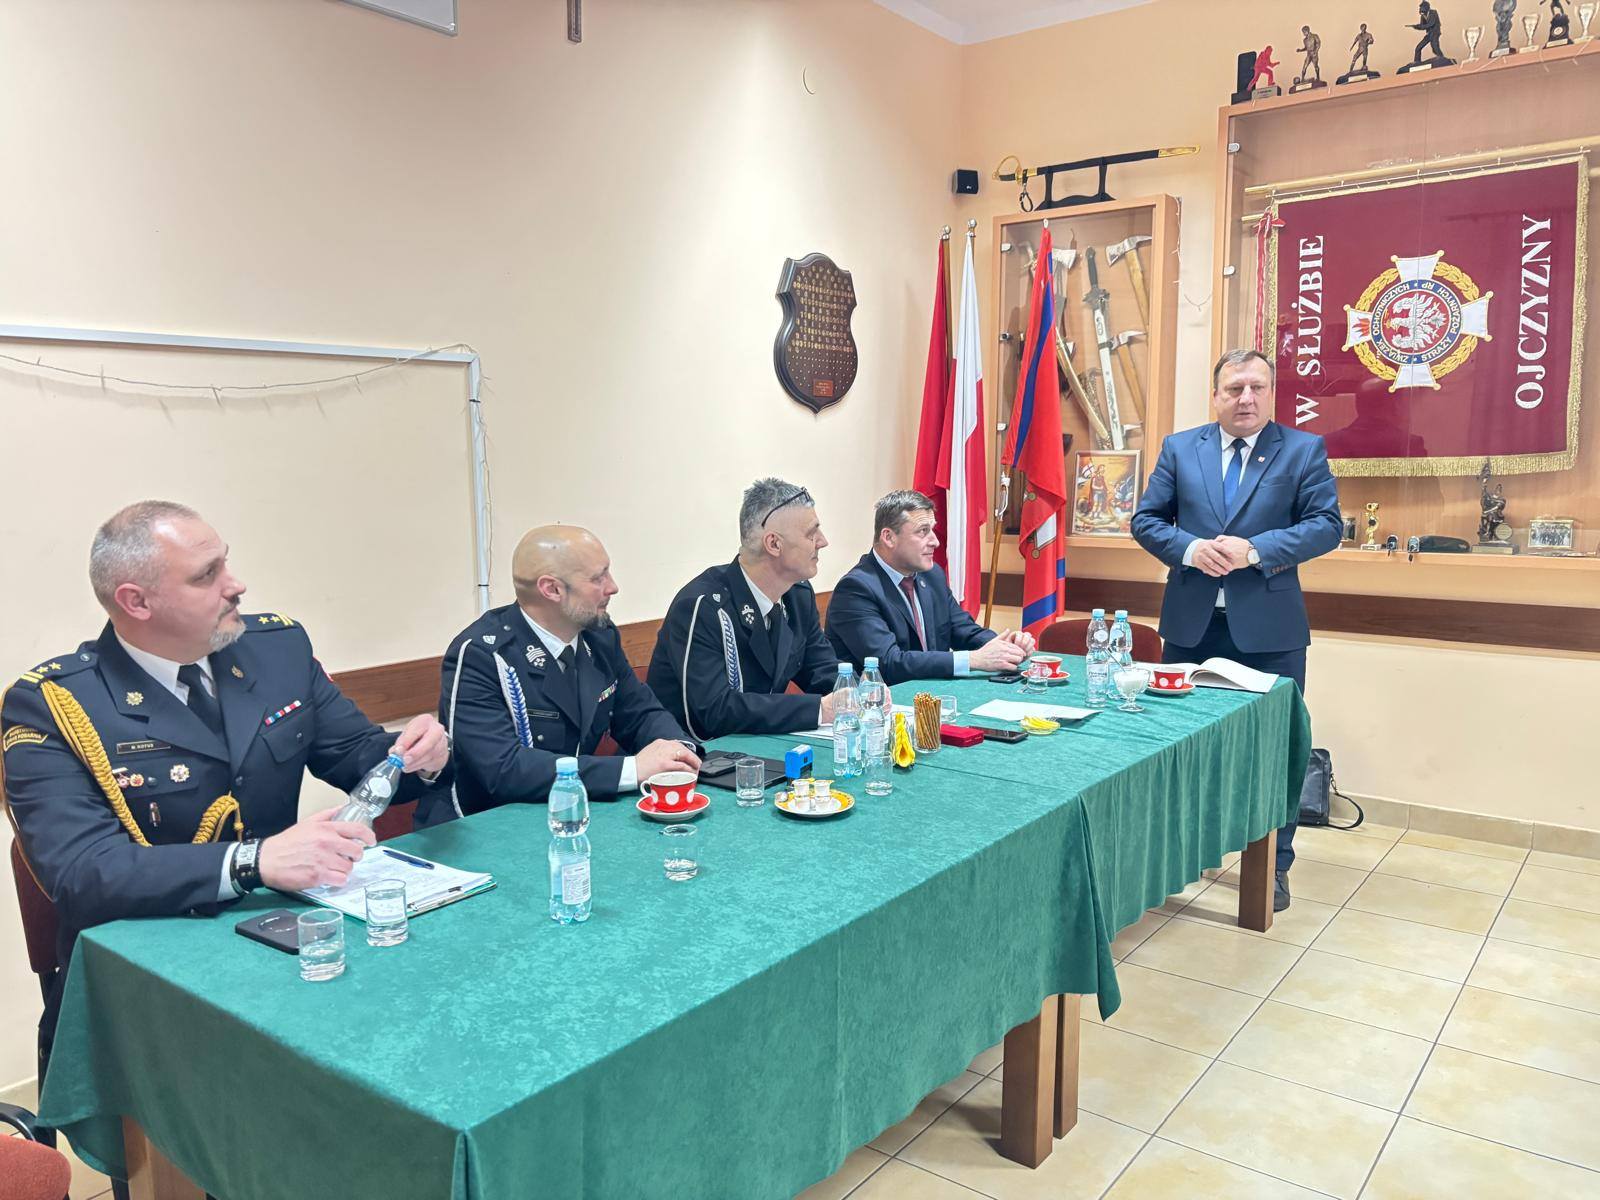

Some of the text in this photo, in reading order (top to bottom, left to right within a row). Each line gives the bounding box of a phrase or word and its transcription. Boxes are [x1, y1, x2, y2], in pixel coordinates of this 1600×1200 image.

[1291, 235, 1324, 427] W SŁUŻBIE
[1372, 283, 1410, 336] OCHOTNICZYCH
[1515, 214, 1551, 410] OJCZYZNY
